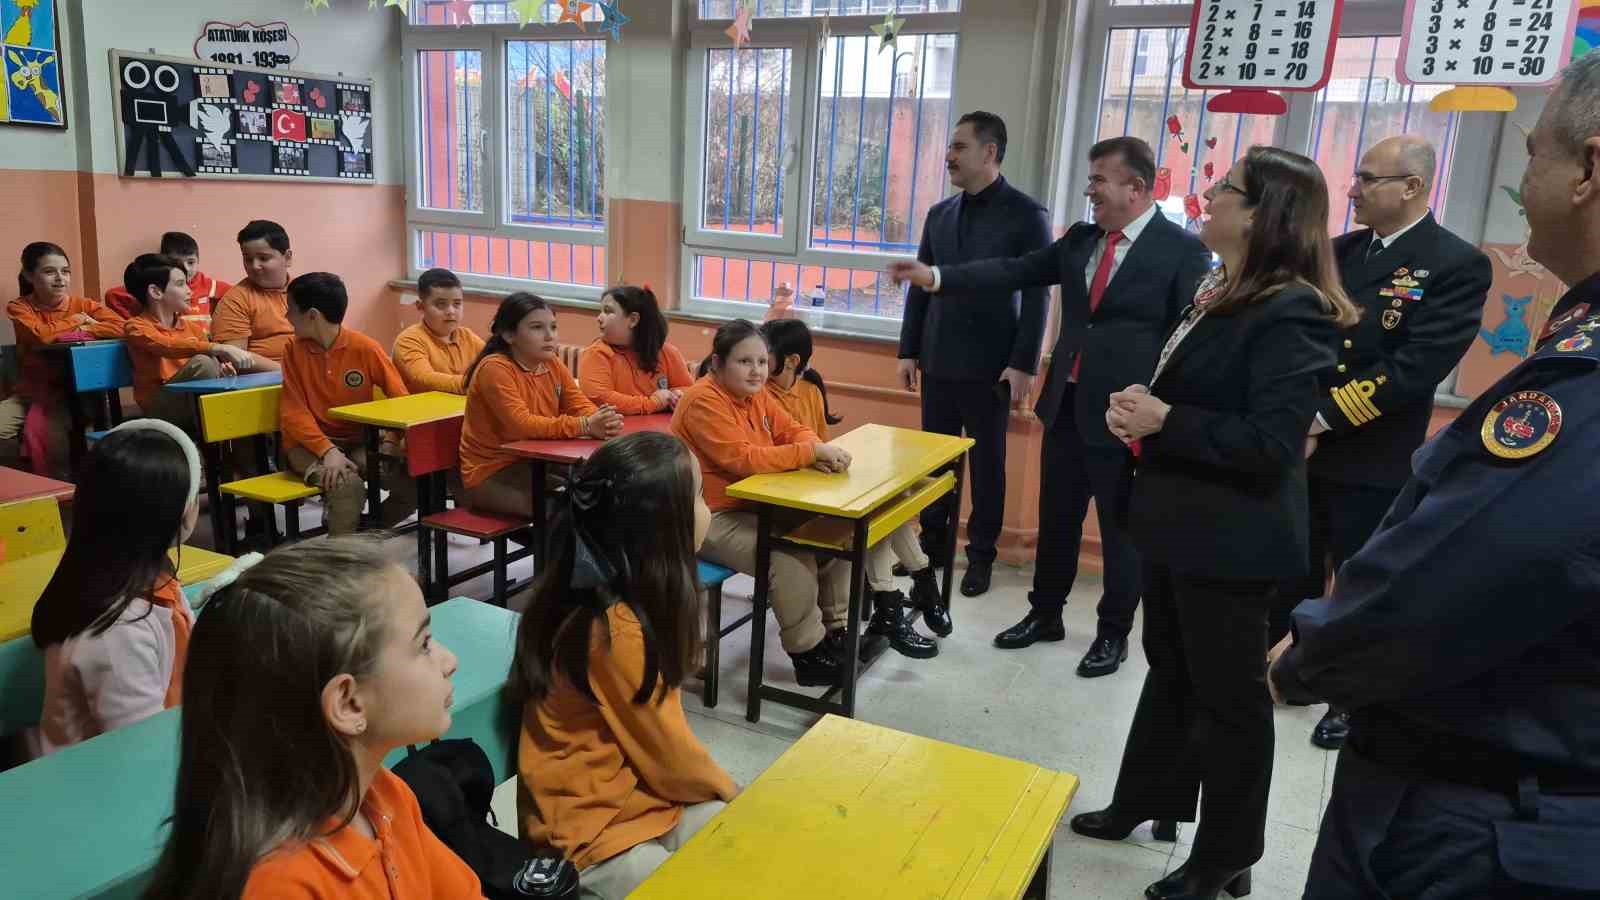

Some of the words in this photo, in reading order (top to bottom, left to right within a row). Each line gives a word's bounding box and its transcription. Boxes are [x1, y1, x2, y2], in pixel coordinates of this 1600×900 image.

[1208, 5, 1219, 22] 2
[1253, 3, 1262, 21] 7
[1298, 1, 1315, 18] 14
[1204, 24, 1215, 41] 2
[1249, 23, 1260, 41] 8
[1294, 21, 1312, 39] 16
[1429, 16, 1441, 33] 3
[1484, 12, 1496, 31] 8
[1528, 12, 1552, 31] 24
[1202, 43, 1212, 60] 2
[1245, 43, 1257, 60] 9
[1291, 41, 1309, 59] 18
[1426, 36, 1438, 54] 3
[1480, 34, 1493, 52] 9
[1524, 35, 1549, 53] 27
[1198, 62, 1210, 79] 2
[1238, 63, 1256, 80] 10
[1284, 63, 1307, 80] 20
[1423, 57, 1435, 75] 3
[1473, 56, 1493, 74] 10
[1519, 57, 1544, 75] 30
[1503, 392, 1561, 429] JANDAR
